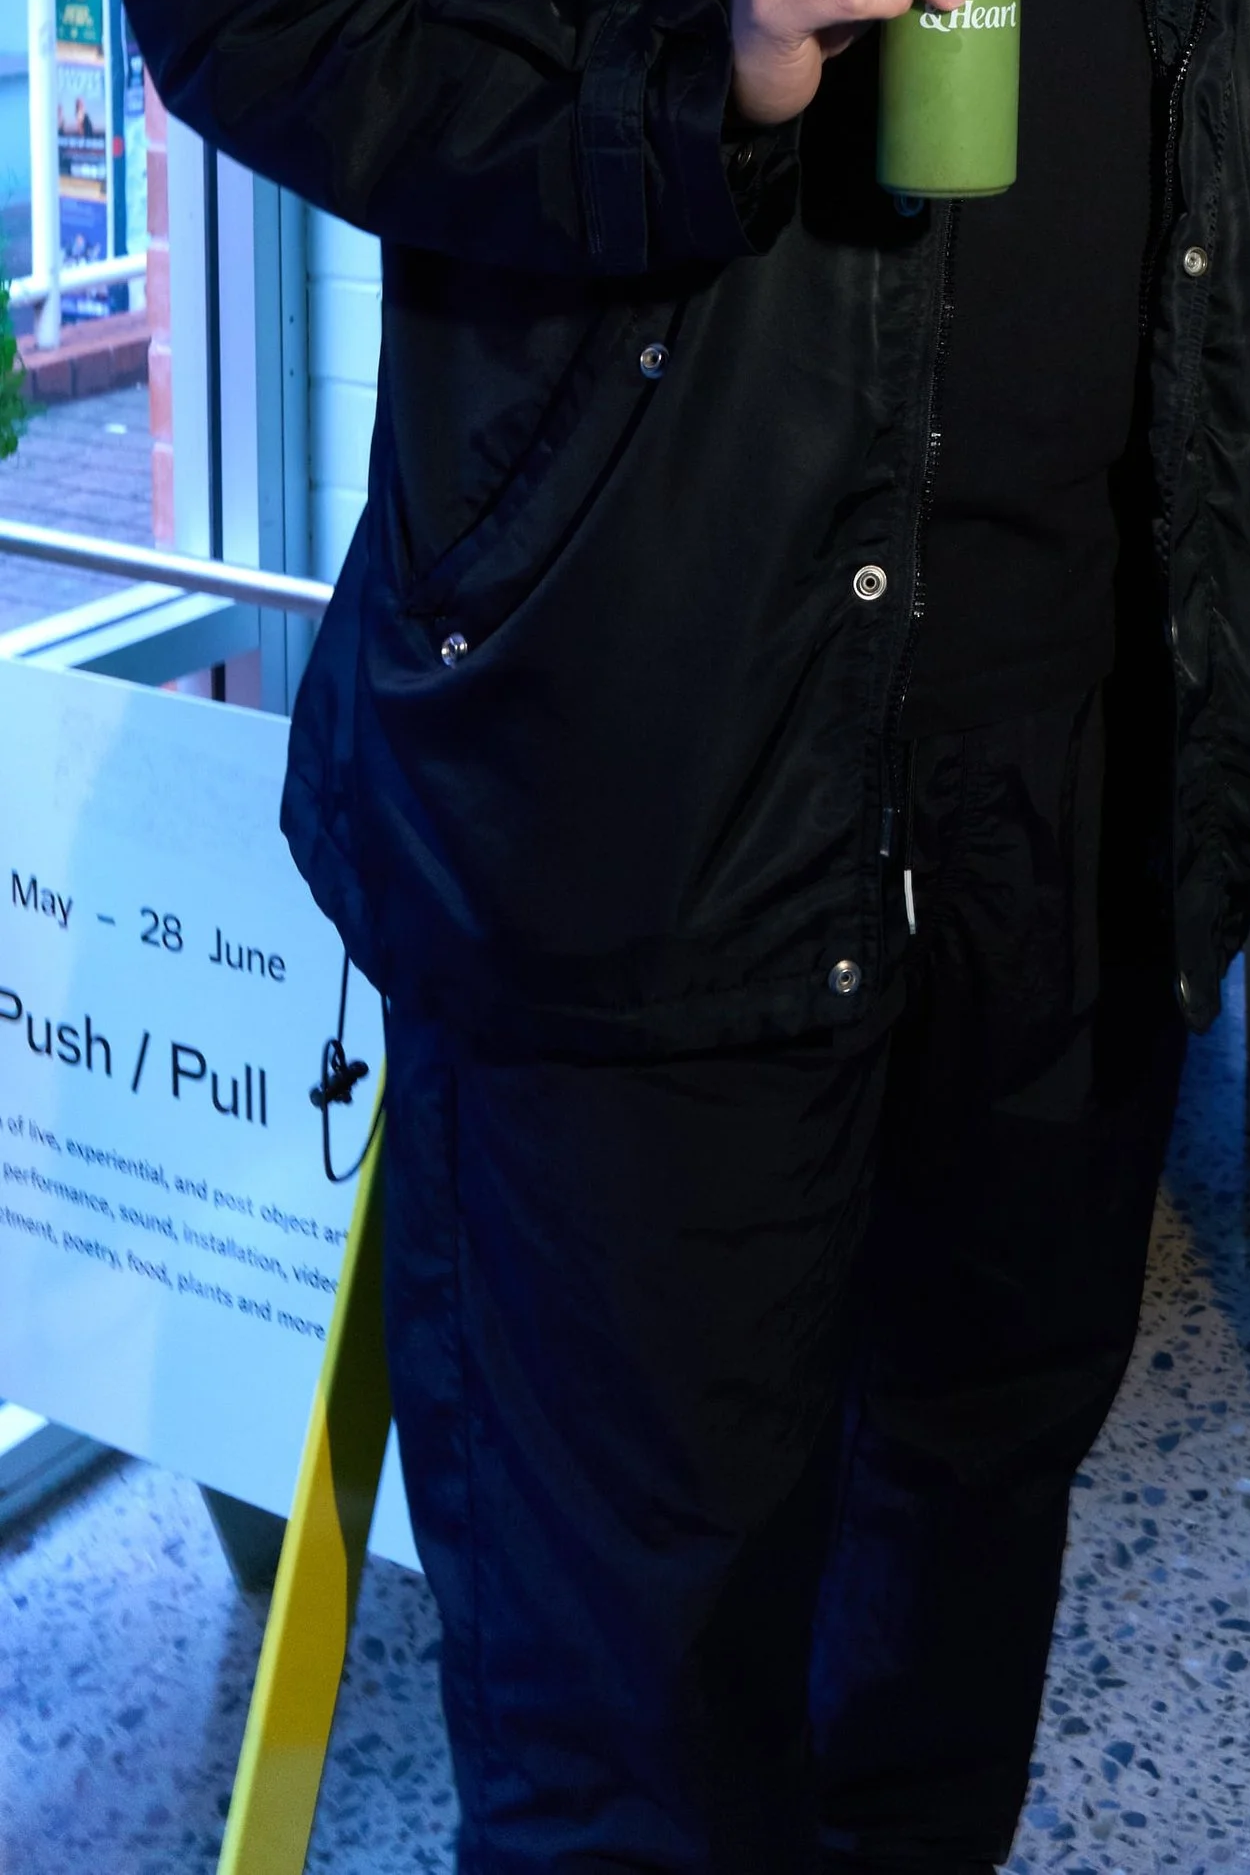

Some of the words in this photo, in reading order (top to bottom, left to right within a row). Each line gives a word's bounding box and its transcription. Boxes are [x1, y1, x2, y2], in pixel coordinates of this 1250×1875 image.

[11, 869, 73, 930] May
[140, 906, 184, 953] 28
[208, 926, 287, 983] June
[131, 1029, 150, 1094] /
[171, 1040, 267, 1128] Pull
[3, 1161, 116, 1223] performance,
[118, 1203, 179, 1244] sound,
[182, 1221, 288, 1283] installation,
[7, 1114, 24, 1137] of
[28, 1118, 62, 1155] live,
[66, 1137, 169, 1192] experiential,
[174, 1174, 208, 1202] and
[213, 1187, 254, 1218] post
[260, 1201, 319, 1240] object
[62, 1230, 123, 1273] poetry,
[126, 1248, 174, 1291] food,
[177, 1271, 234, 1309] plants
[237, 1298, 272, 1323] and
[277, 1308, 326, 1342] more
